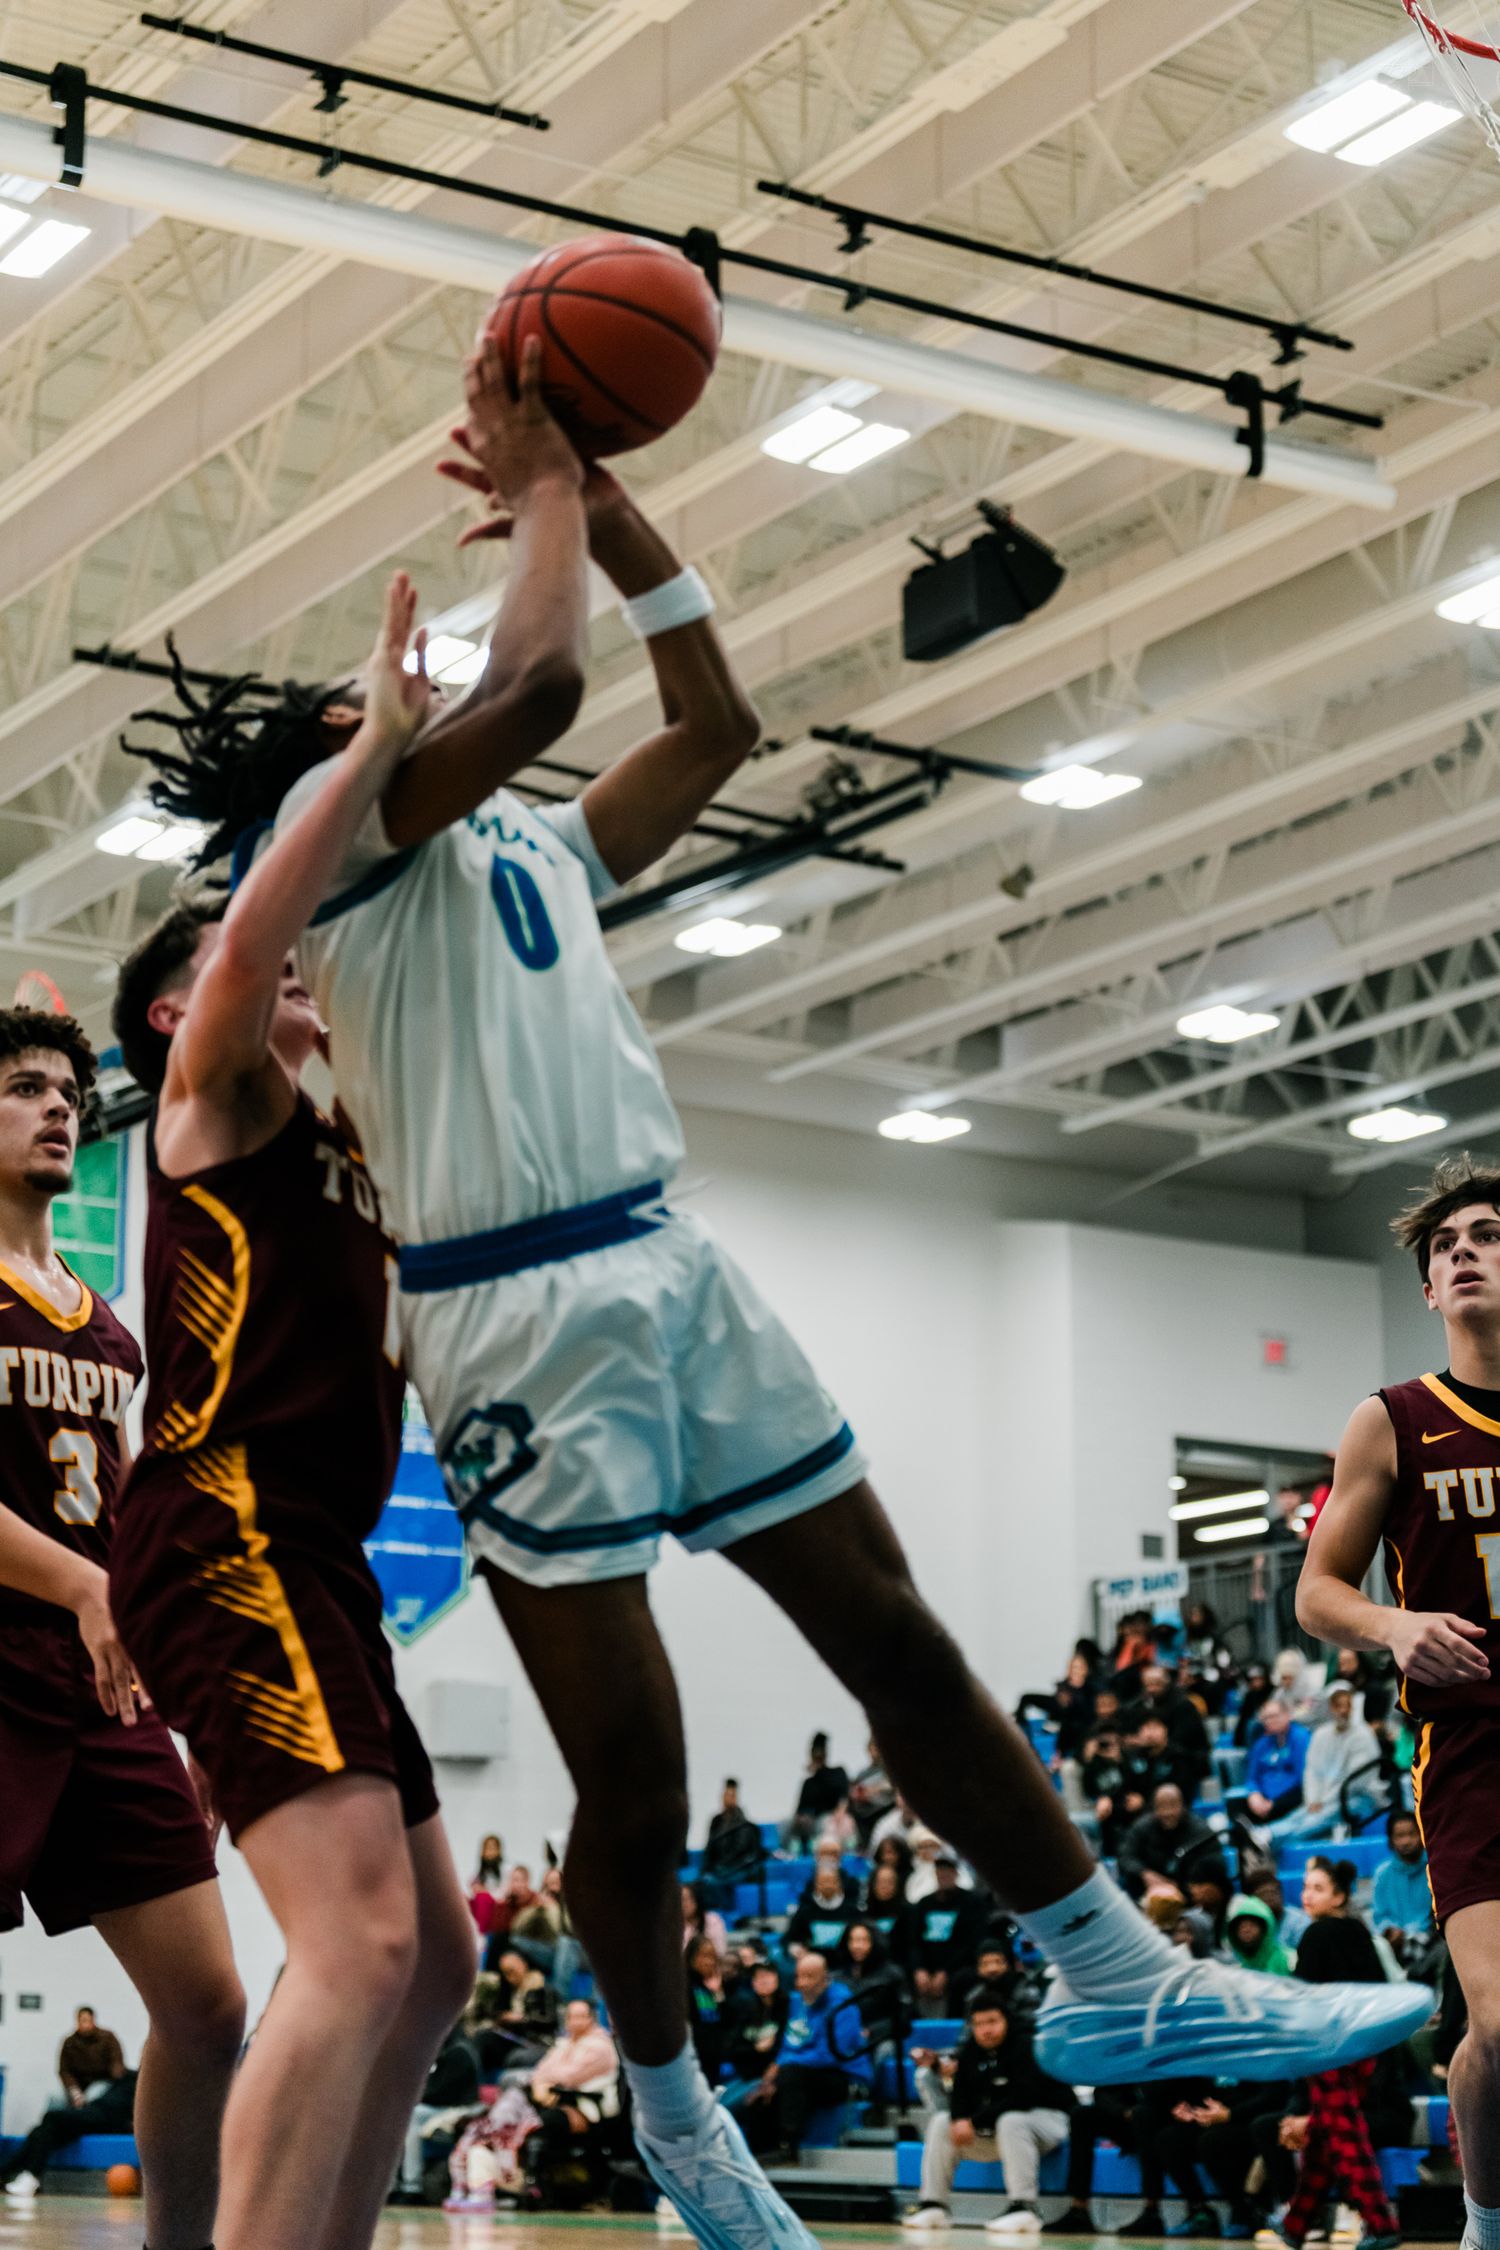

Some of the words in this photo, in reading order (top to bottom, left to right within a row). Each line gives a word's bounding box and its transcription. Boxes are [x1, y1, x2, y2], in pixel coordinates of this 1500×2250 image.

[490, 852, 561, 972] 0
[49, 1427, 101, 1527] 3
[1423, 1467, 1500, 1522] TU
